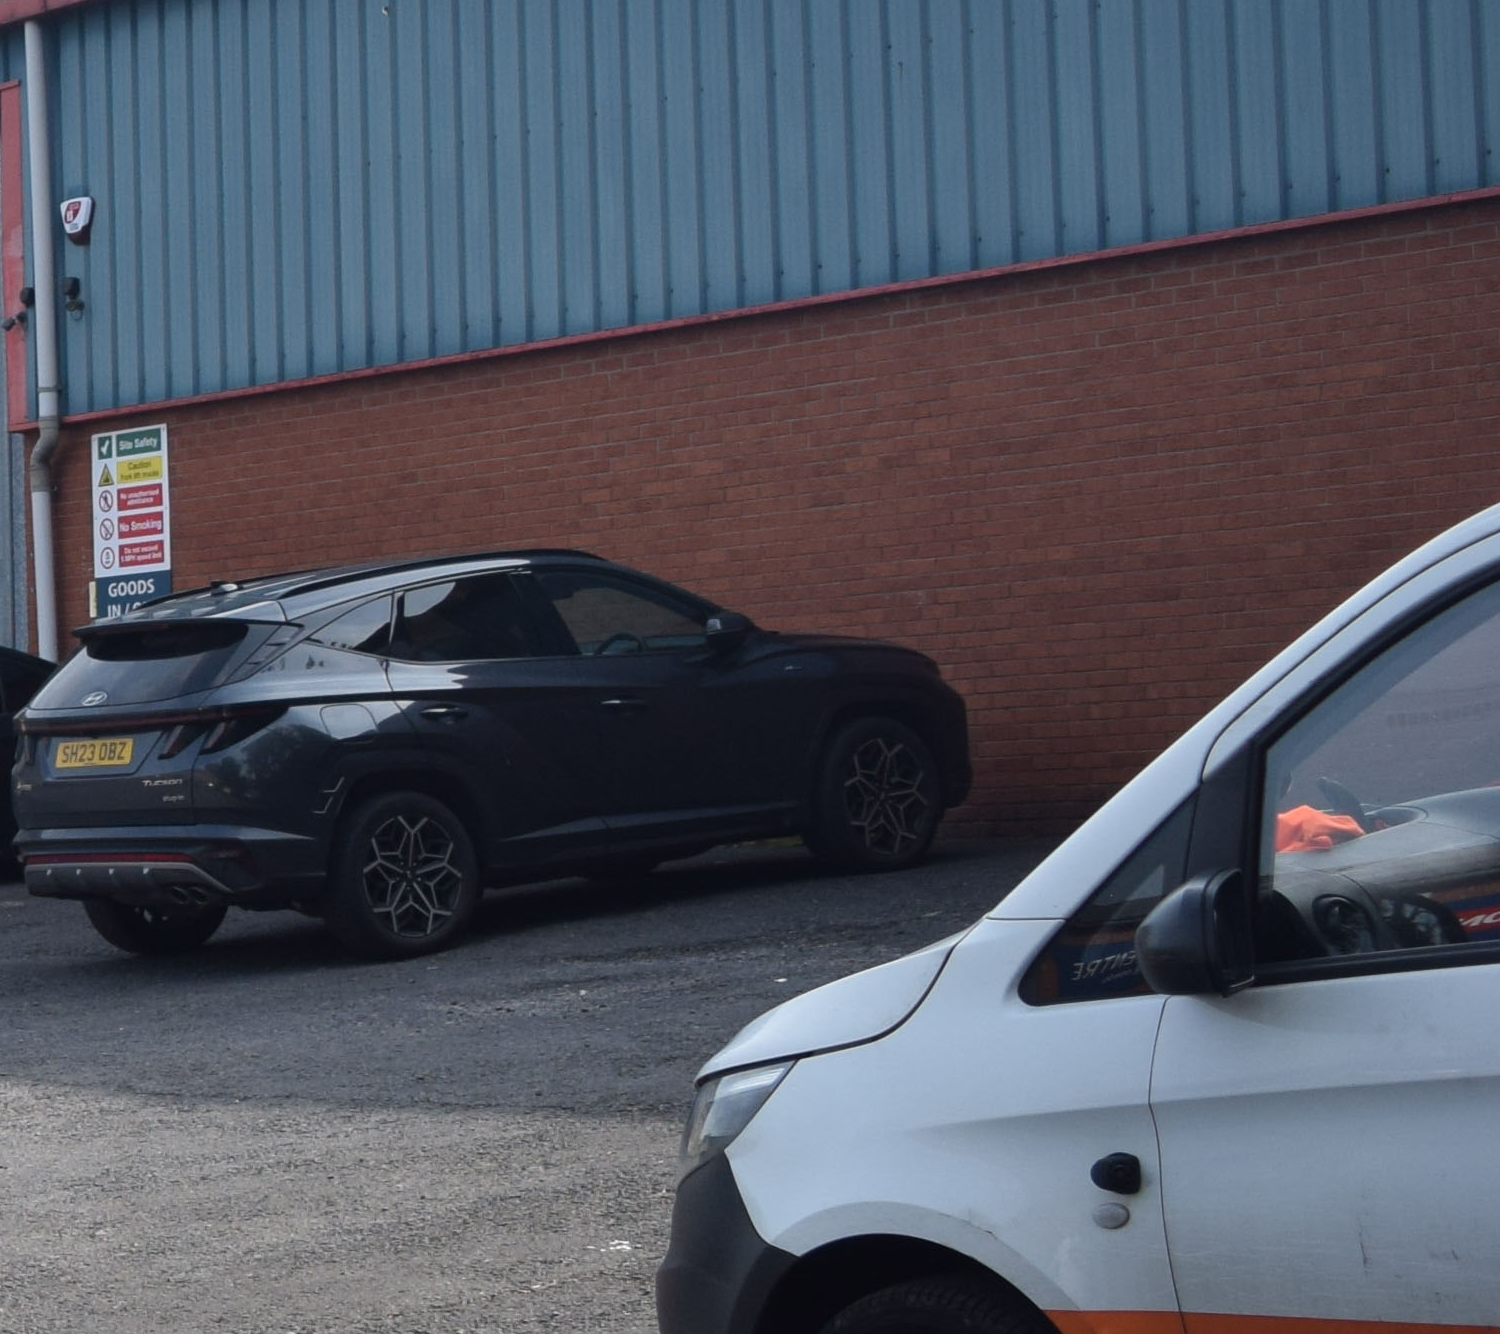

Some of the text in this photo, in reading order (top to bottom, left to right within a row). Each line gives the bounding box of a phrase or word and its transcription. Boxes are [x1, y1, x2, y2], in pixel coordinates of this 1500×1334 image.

[119, 437, 157, 450] Site Safety
[131, 520, 161, 530] Smoking
[108, 579, 155, 597] GOODS
[108, 604, 121, 617] IN
[61, 741, 127, 763] SH23 OBZ
